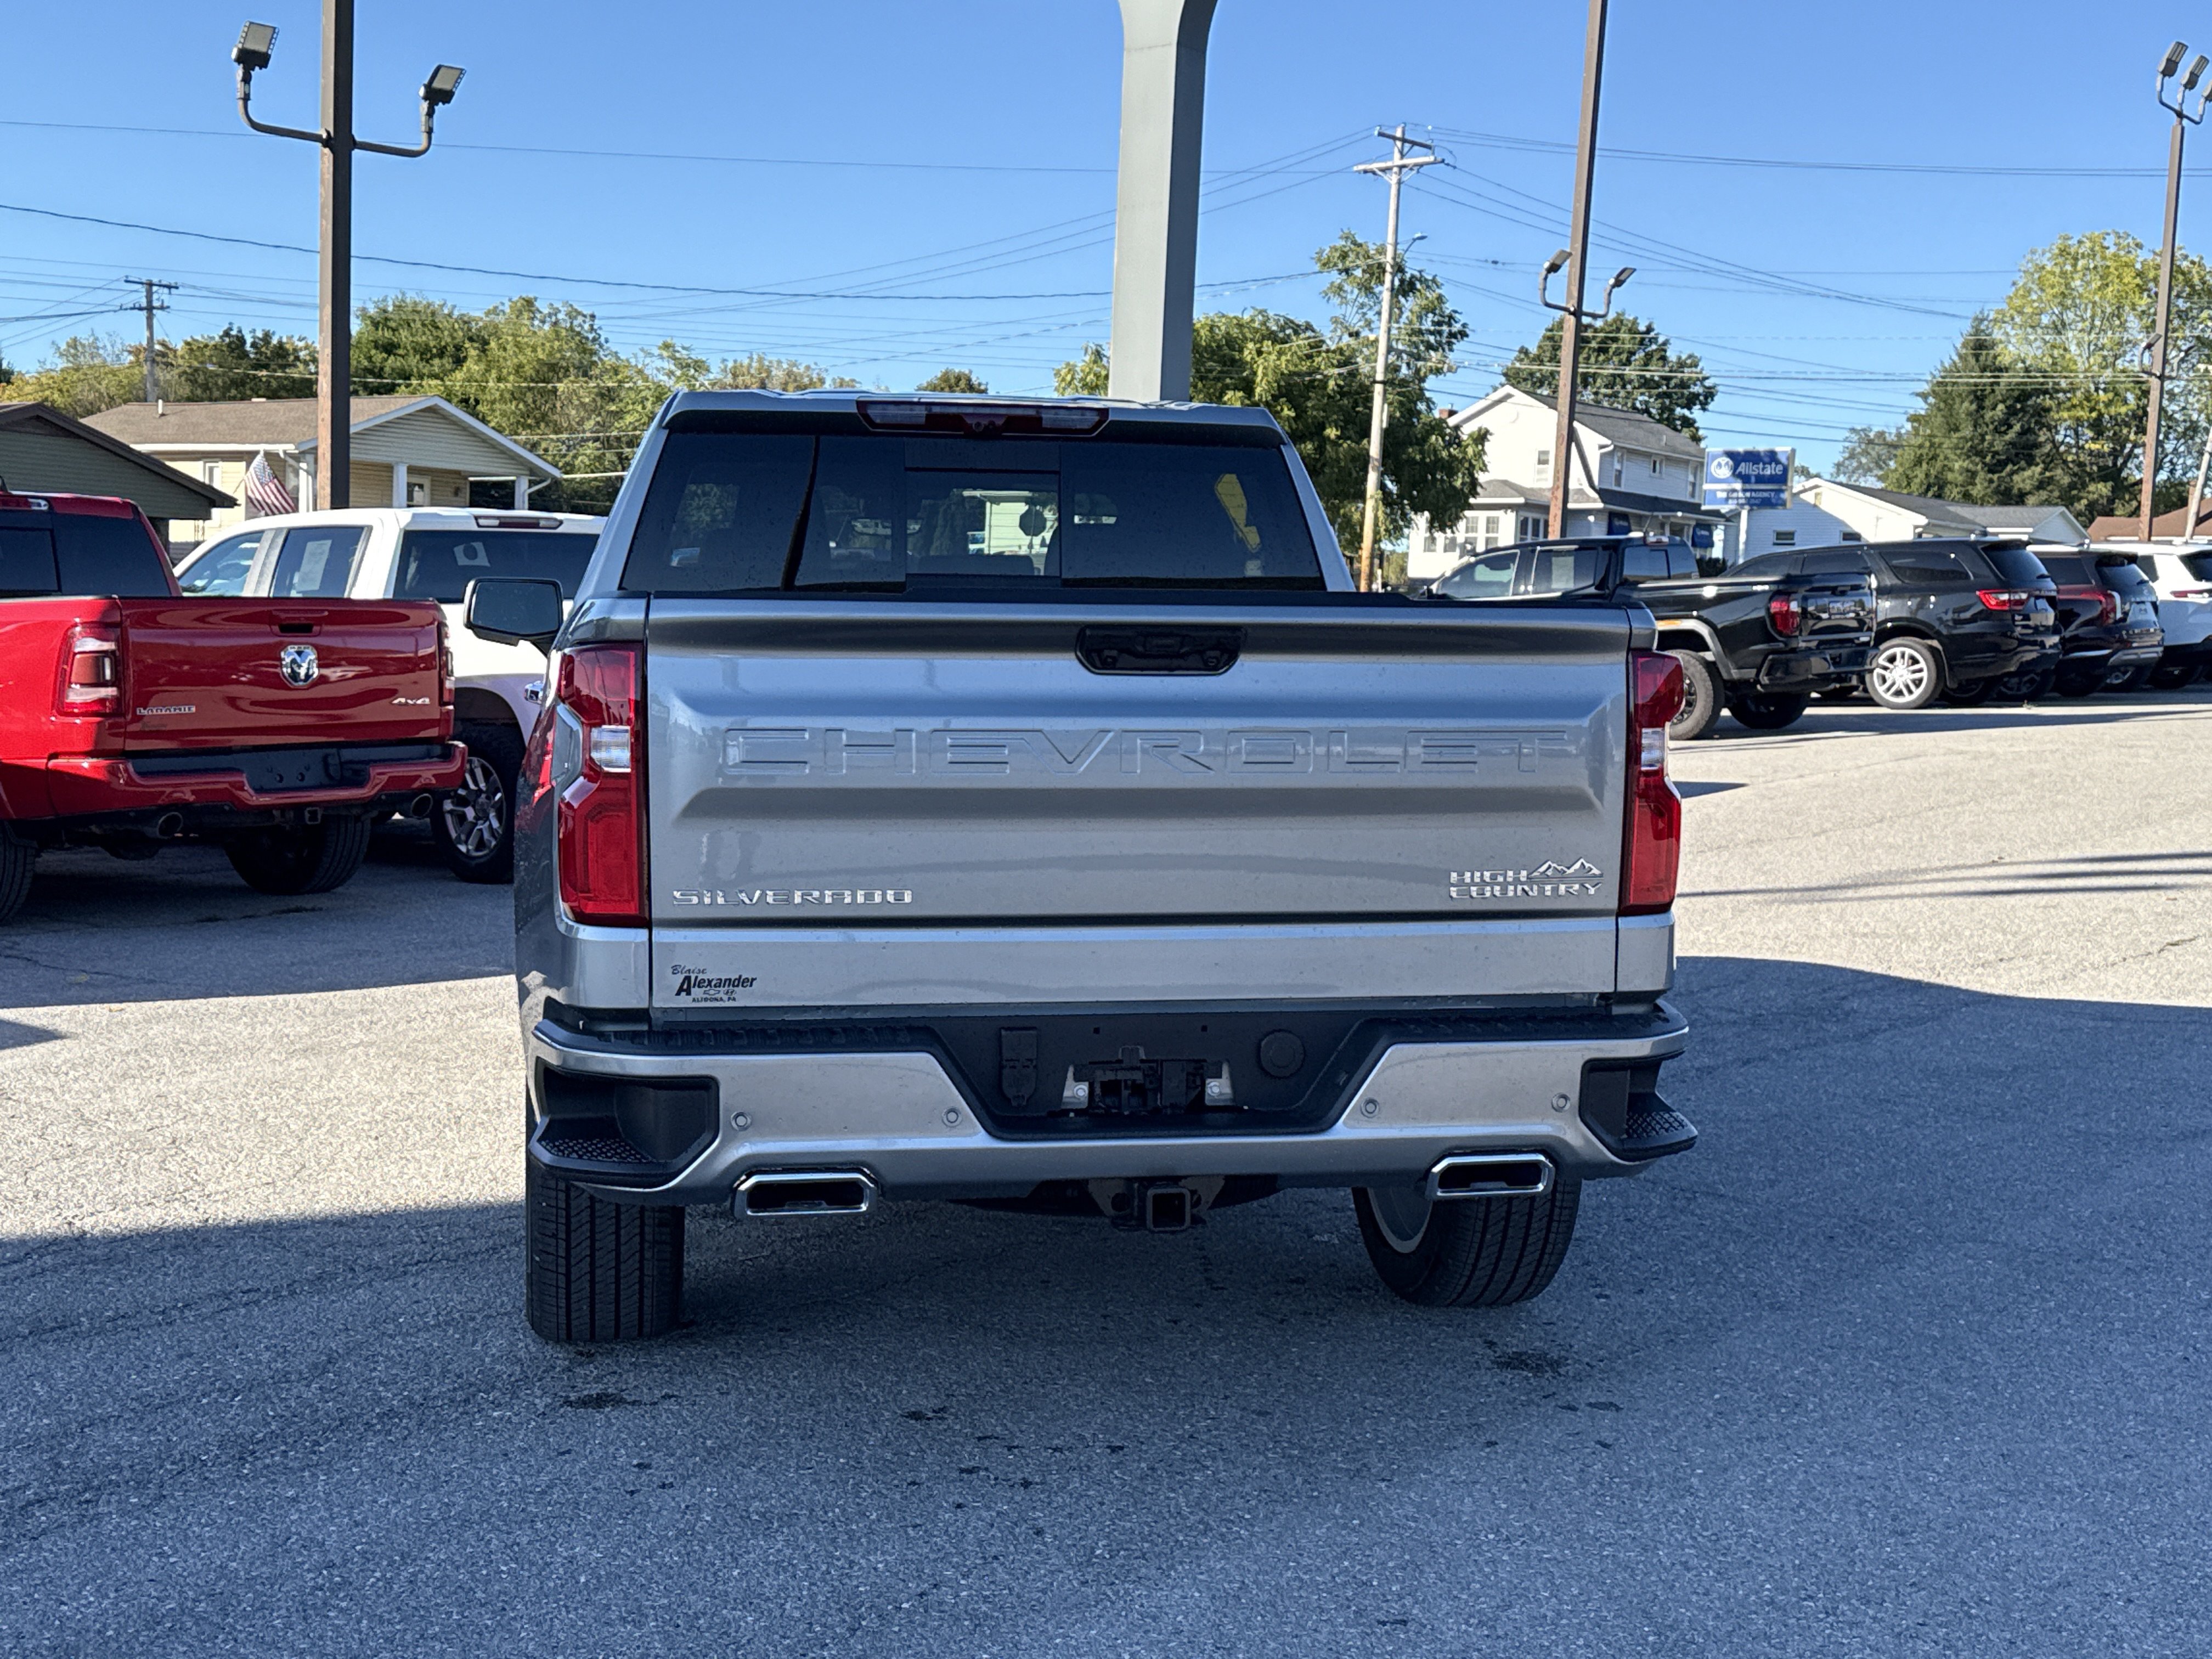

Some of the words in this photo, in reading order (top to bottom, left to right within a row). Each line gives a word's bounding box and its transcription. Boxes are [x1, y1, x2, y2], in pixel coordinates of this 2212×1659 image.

[1735, 461, 1783, 475] Allstate
[391, 697, 431, 705] 4x4
[137, 705, 196, 715] LARAMIE
[719, 727, 1569, 778] CHEVROLET
[1449, 869, 1527, 884] HIGH
[672, 889, 913, 905] SILVERADO
[1449, 883, 1603, 899] COUNTRY
[671, 964, 707, 975] Blaise
[675, 974, 757, 996] Alexander
